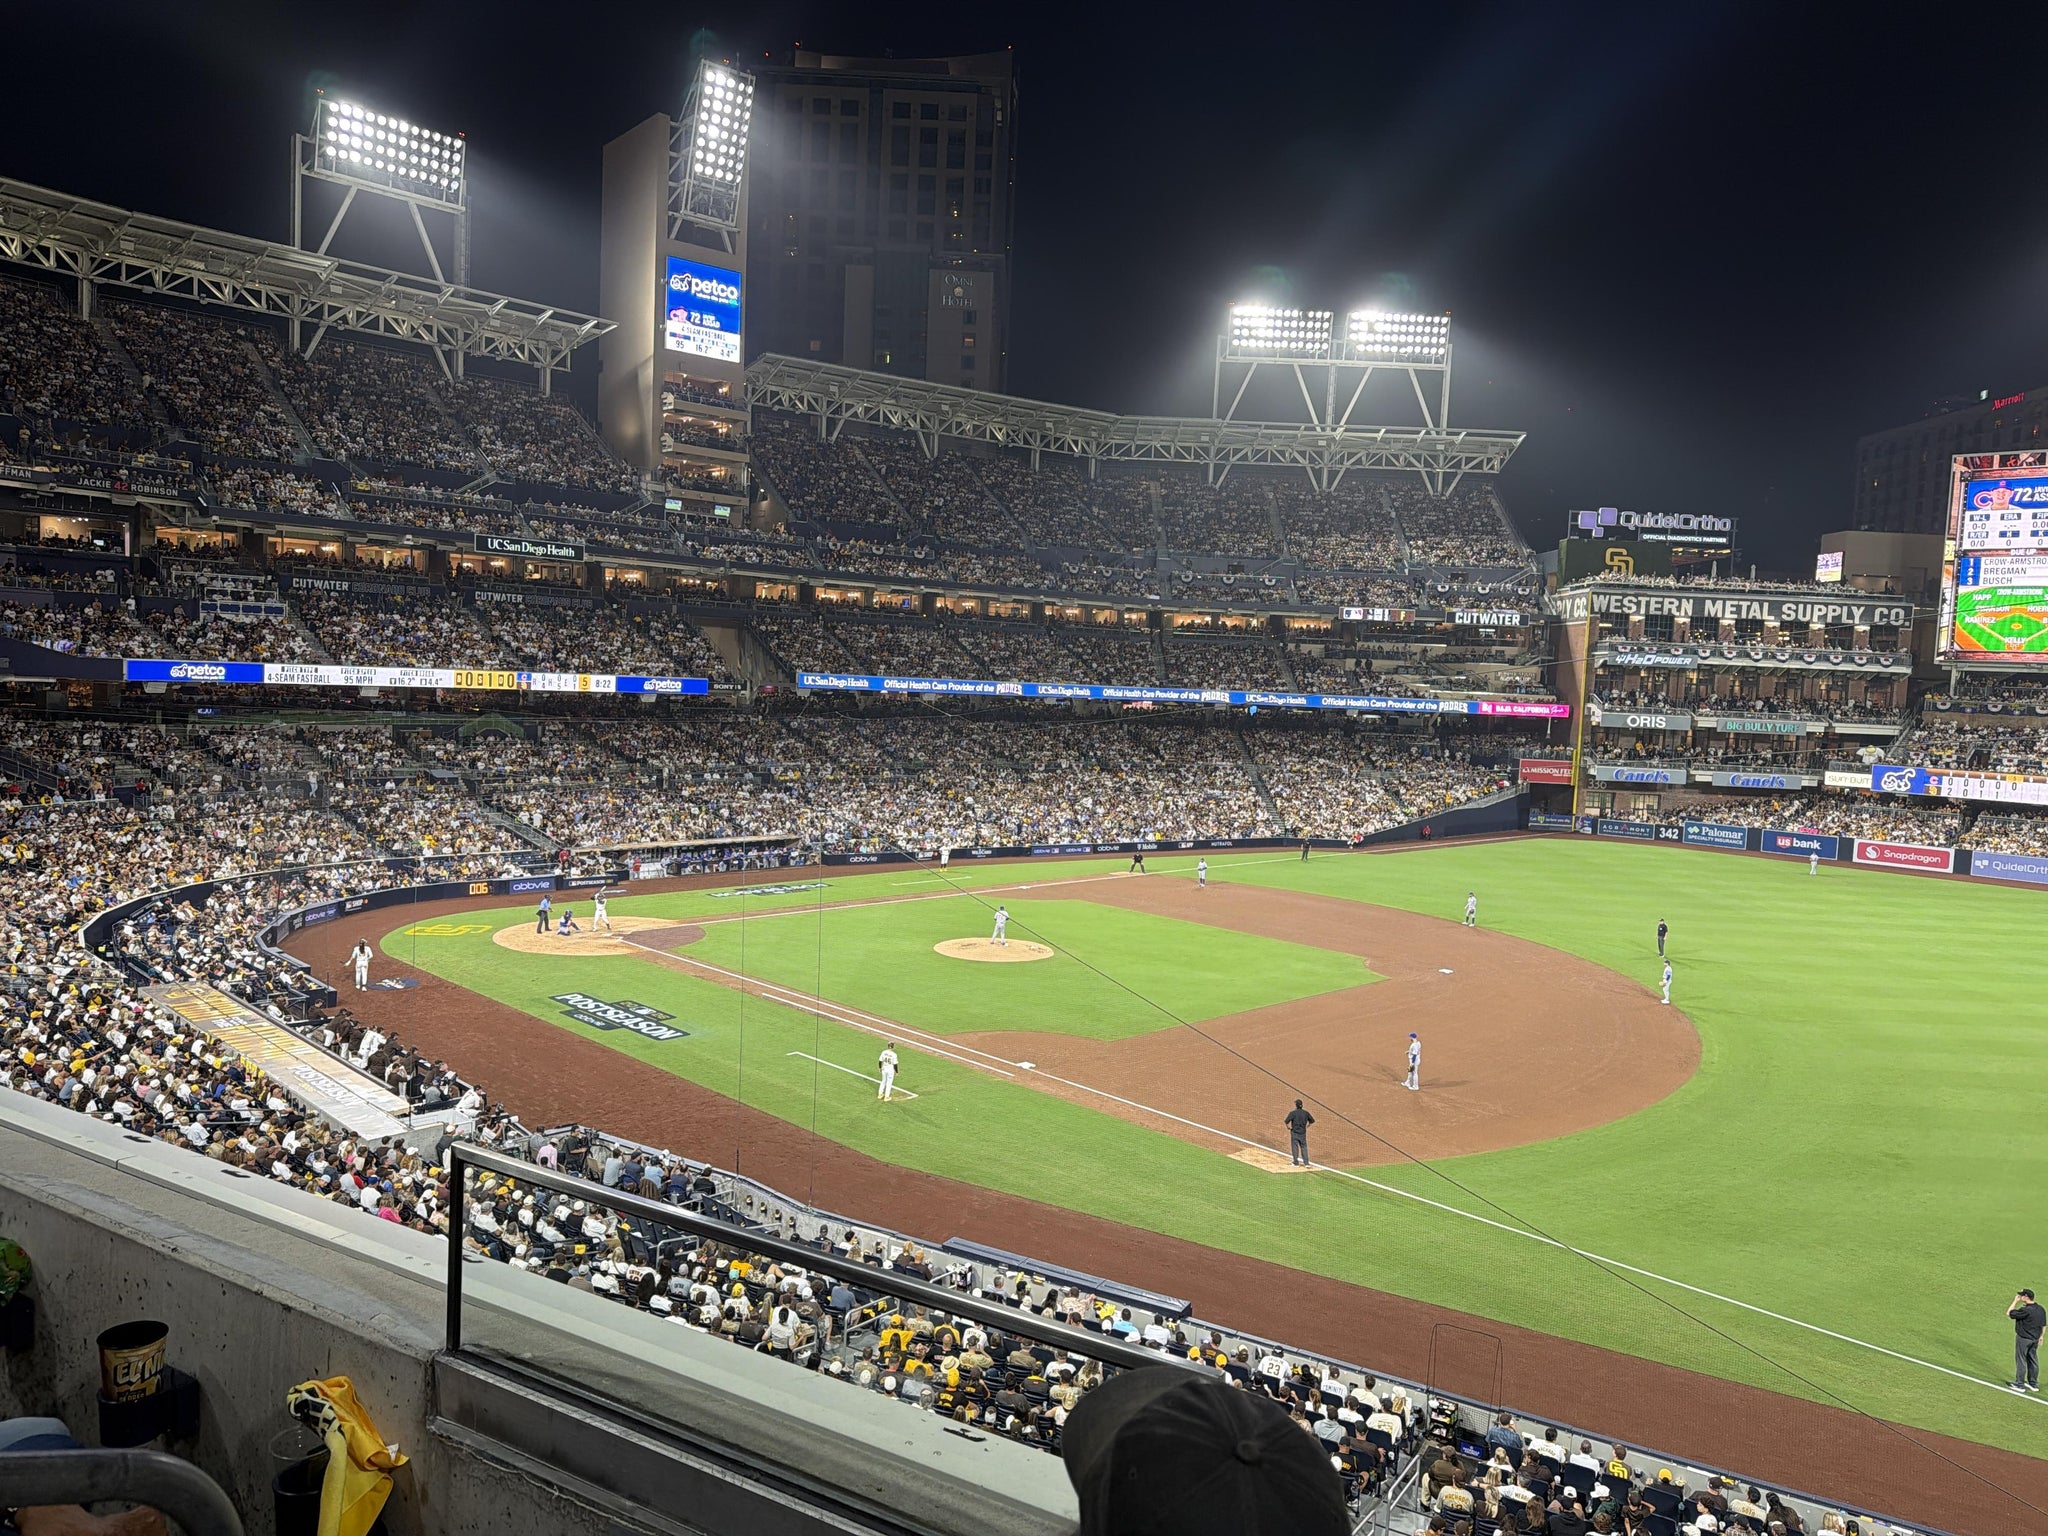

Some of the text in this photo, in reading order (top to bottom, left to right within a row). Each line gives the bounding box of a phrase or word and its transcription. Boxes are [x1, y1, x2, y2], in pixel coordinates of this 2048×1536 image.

[691, 277, 739, 299] petco
[689, 311, 701, 324] 72
[675, 339, 685, 349] 95
[77, 477, 179, 497] JACKIE 42 ROBINSON
[2014, 487, 2033, 502] 72
[1620, 511, 1731, 532] QuidelOrtho
[1667, 535, 1703, 543] DIAGNOSTICS
[487, 537, 575, 558] UC San Diego Health
[2010, 548, 2025, 556] DUE
[1967, 567, 1974, 576] 2
[1983, 567, 2027, 575] BREGMAN
[292, 577, 349, 591] CUTWATER
[1966, 577, 1973, 585] 3
[1983, 577, 2013, 585] BUSCH
[474, 590, 524, 604] CUTWATER
[1592, 594, 1910, 626] WESTERN METAL SUPPLY CO.
[1455, 611, 1521, 626] CUTWATER
[2004, 636, 2027, 644] KELLY
[188, 663, 226, 677] petco
[267, 673, 331, 684] 4-SEAM FASTBALL
[344, 675, 373, 685] 95 MPH
[465, 672, 473, 687] 0
[507, 673, 515, 688] 0
[581, 676, 588, 687] 5
[595, 679, 612, 689] 8:22
[656, 679, 682, 690] petco
[803, 676, 869, 687] UC San Diego Health
[884, 680, 1023, 695] Official Health Care Provider of the PADRES
[1038, 686, 1091, 696] UC San Diego Health
[1103, 688, 1229, 703] Official Health Care Provider of the PADRES
[1246, 694, 1256, 702] UC
[1286, 696, 1307, 705] Health
[1322, 697, 1468, 713] Official Health Care Provider of the PADRES
[1495, 705, 1513, 713] BAJA
[1513, 706, 1550, 714] CALIFORNIA
[1626, 715, 1667, 728] ORIS
[1726, 721, 1800, 733] BIG BULLY TURF
[1531, 767, 1559, 775] MISSION
[1948, 777, 2017, 791] 0 0 0 0 0
[1947, 787, 1968, 797] 2 0
[1659, 827, 1679, 839] 342
[1701, 826, 1744, 840] Palomar
[1688, 834, 1743, 845] SPECIALTY INSURANCE
[1777, 836, 1821, 850] us bank
[849, 854, 878, 863] abbvie
[1883, 849, 1942, 864] Snapdragon
[469, 882, 489, 895] 006
[512, 880, 550, 891] abbvie
[305, 911, 326, 922] abbvie
[555, 993, 683, 1040] POSTSEASON
[116, 1359, 142, 1385] EL
[1266, 1362, 1281, 1376] 23
